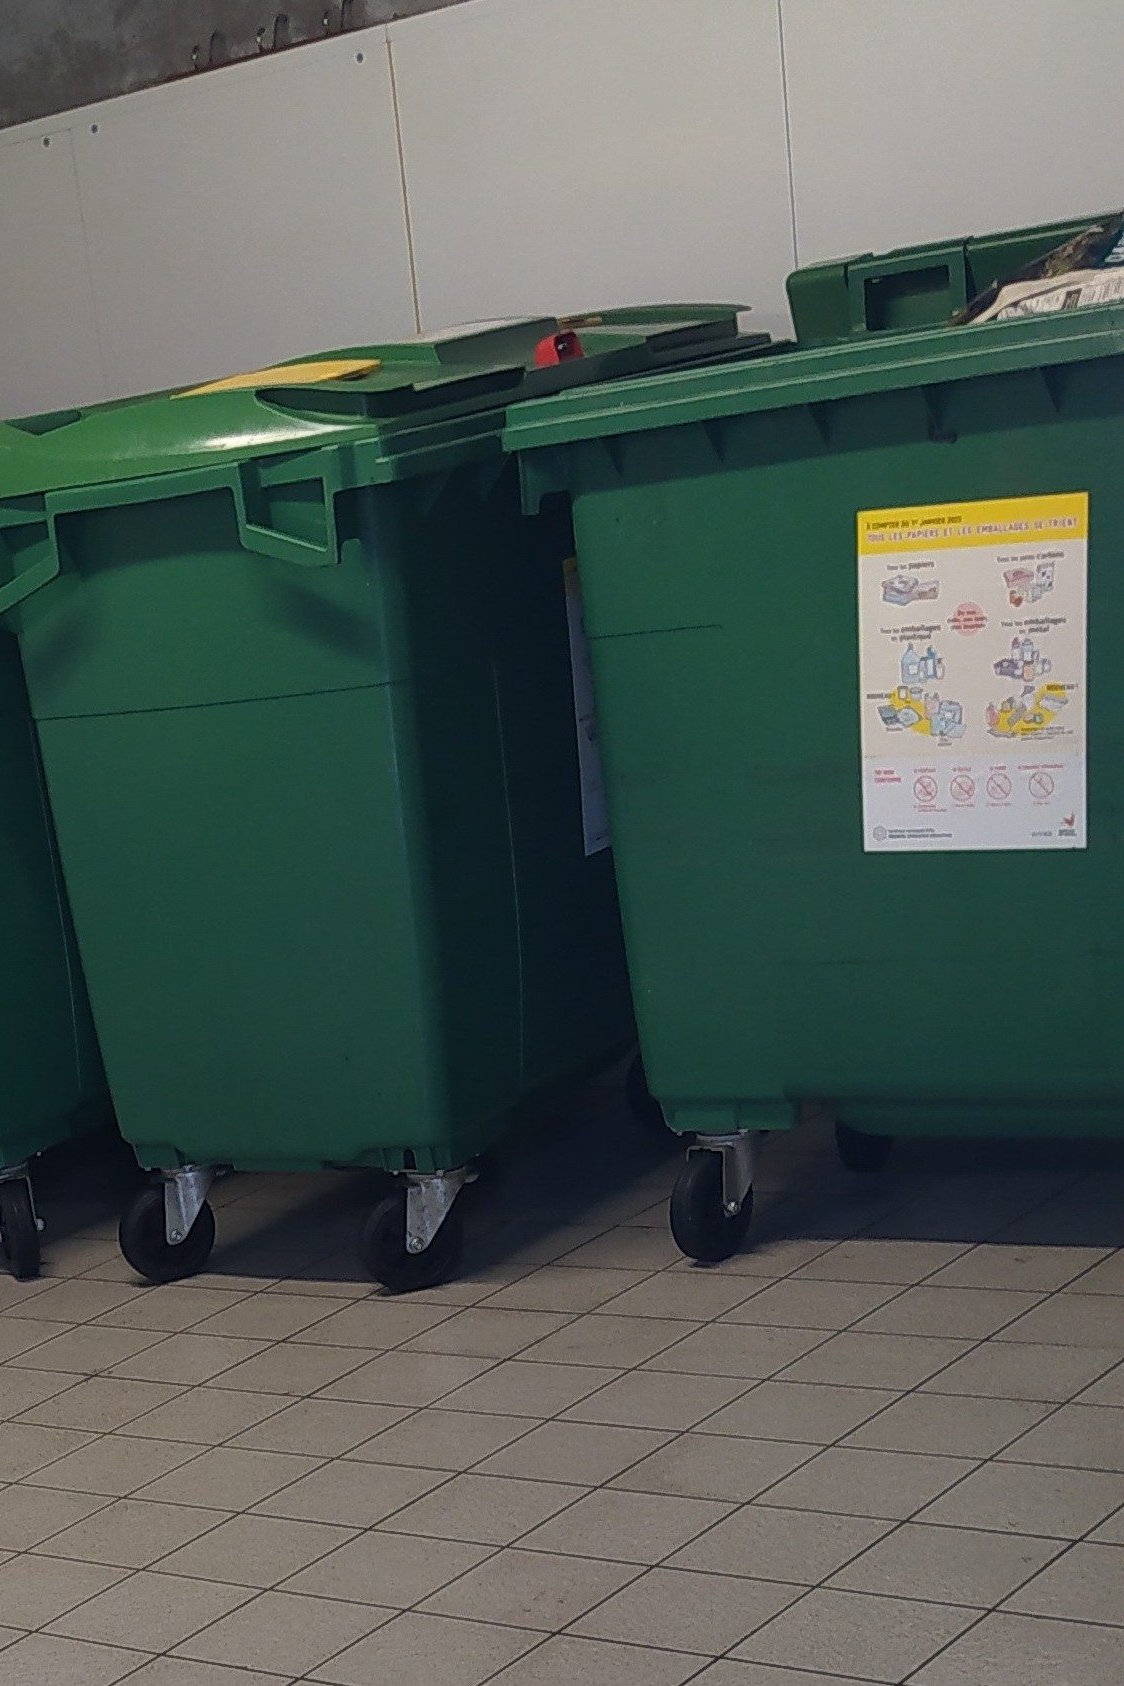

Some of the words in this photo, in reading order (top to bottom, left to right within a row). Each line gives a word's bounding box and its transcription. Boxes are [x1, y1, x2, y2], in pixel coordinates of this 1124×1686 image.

[868, 533, 885, 543] TOUS
[889, 532, 903, 541] LES
[906, 528, 940, 539] PAPIERS
[943, 527, 954, 537] ET
[957, 525, 973, 536] LES
[976, 521, 1030, 534] EMBALLAGES
[1034, 520, 1044, 530] SE
[1049, 516, 1078, 528] TRIENT
[1023, 617, 1067, 627] emballages
[901, 623, 942, 634] emballages
